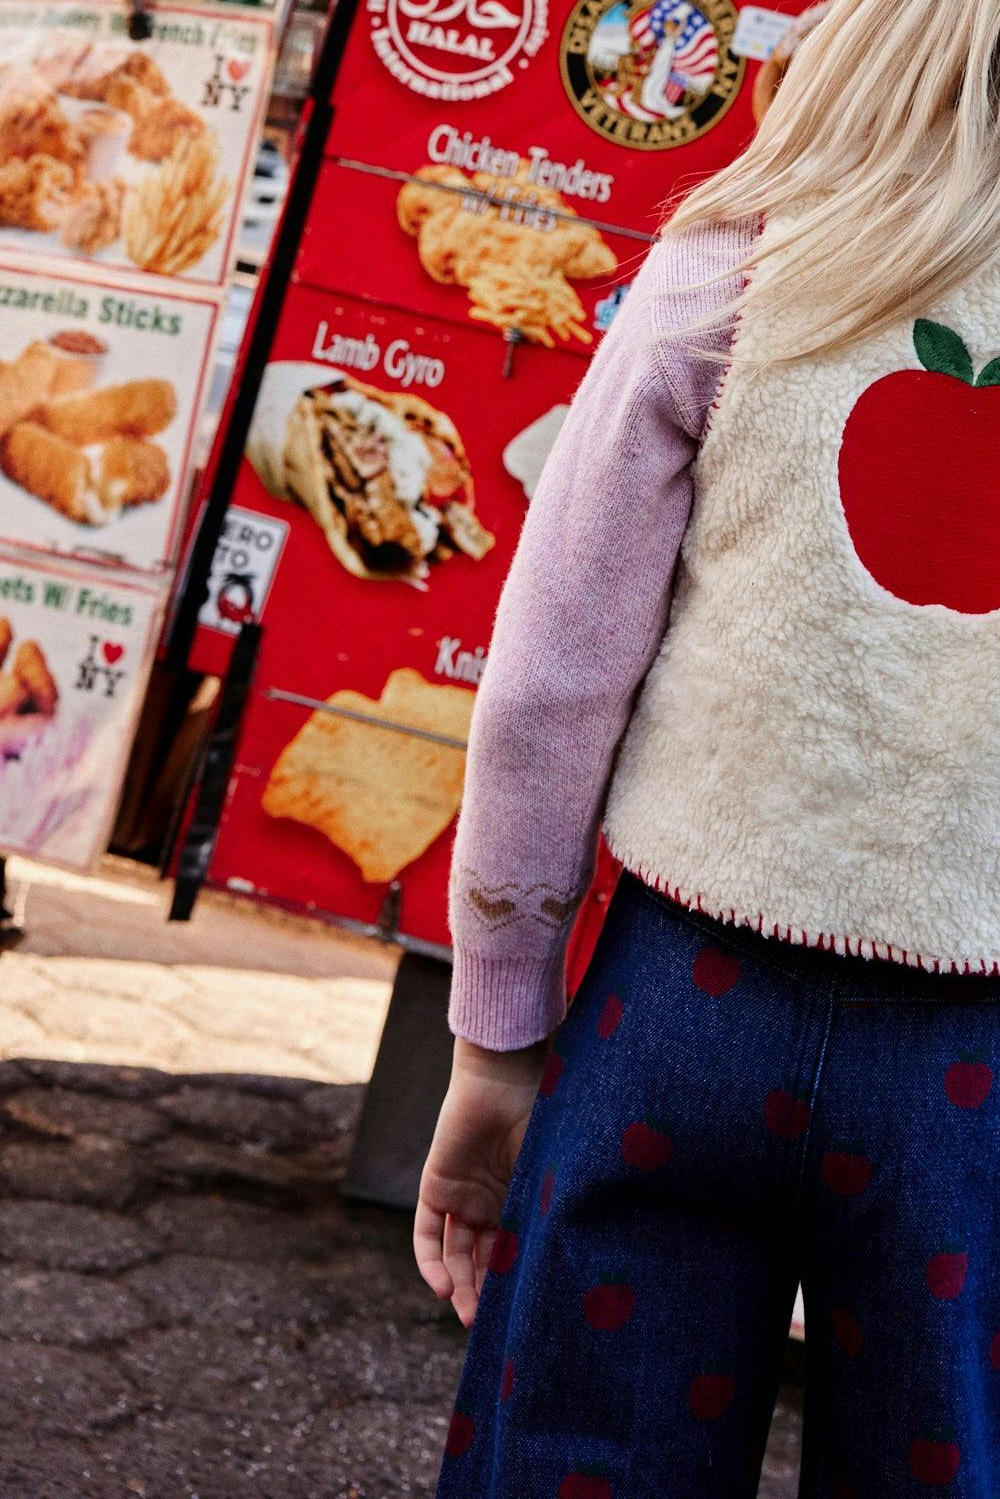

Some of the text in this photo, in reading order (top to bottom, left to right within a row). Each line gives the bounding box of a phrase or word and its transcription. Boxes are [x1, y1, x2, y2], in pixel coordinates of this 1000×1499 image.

[405, 20, 496, 62] HALAL
[427, 123, 615, 203] Chicken Tenders
[0, 285, 182, 336] zarella Sticks
[311, 320, 445, 388] Lamb Gyro
[76, 587, 133, 627] Fries
[75, 662, 127, 697] NY
